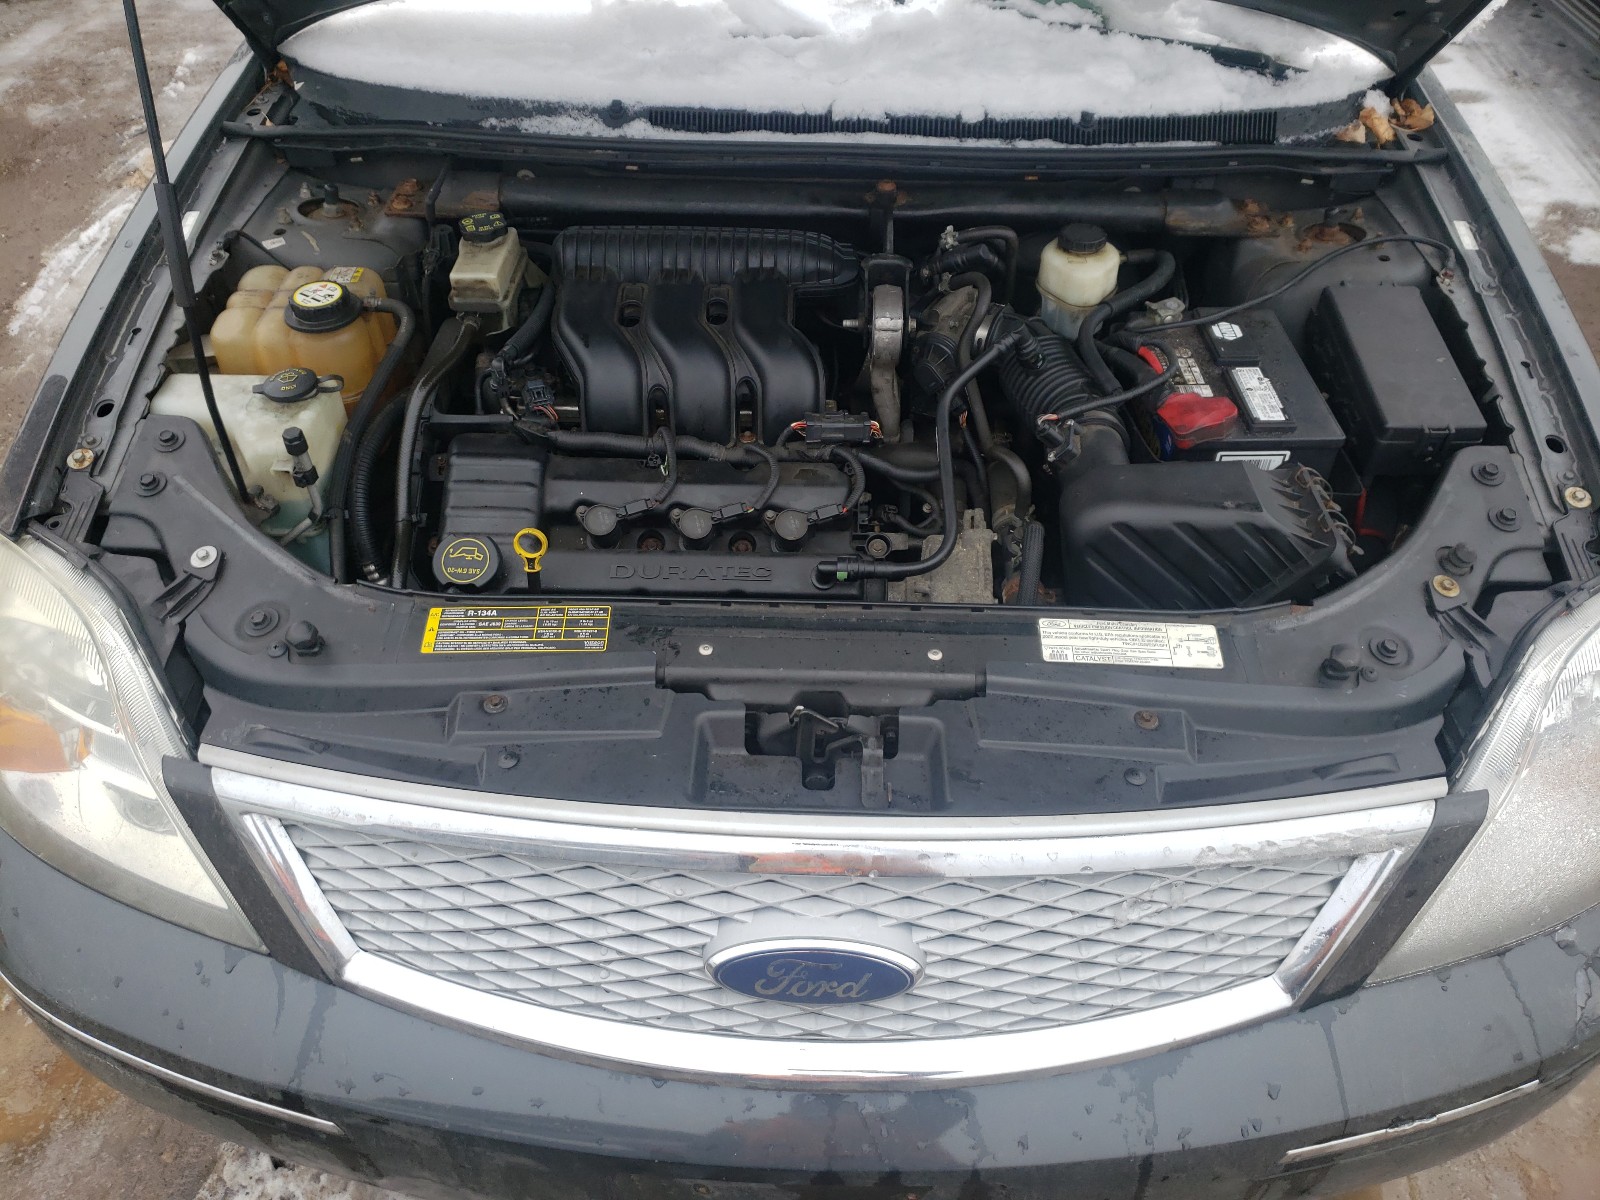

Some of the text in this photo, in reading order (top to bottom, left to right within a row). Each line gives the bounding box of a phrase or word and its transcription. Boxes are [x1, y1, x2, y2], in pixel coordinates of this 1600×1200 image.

[609, 564, 772, 581] DURATEC
[467, 609, 498, 617] R-134A
[754, 958, 873, 998] Ford
